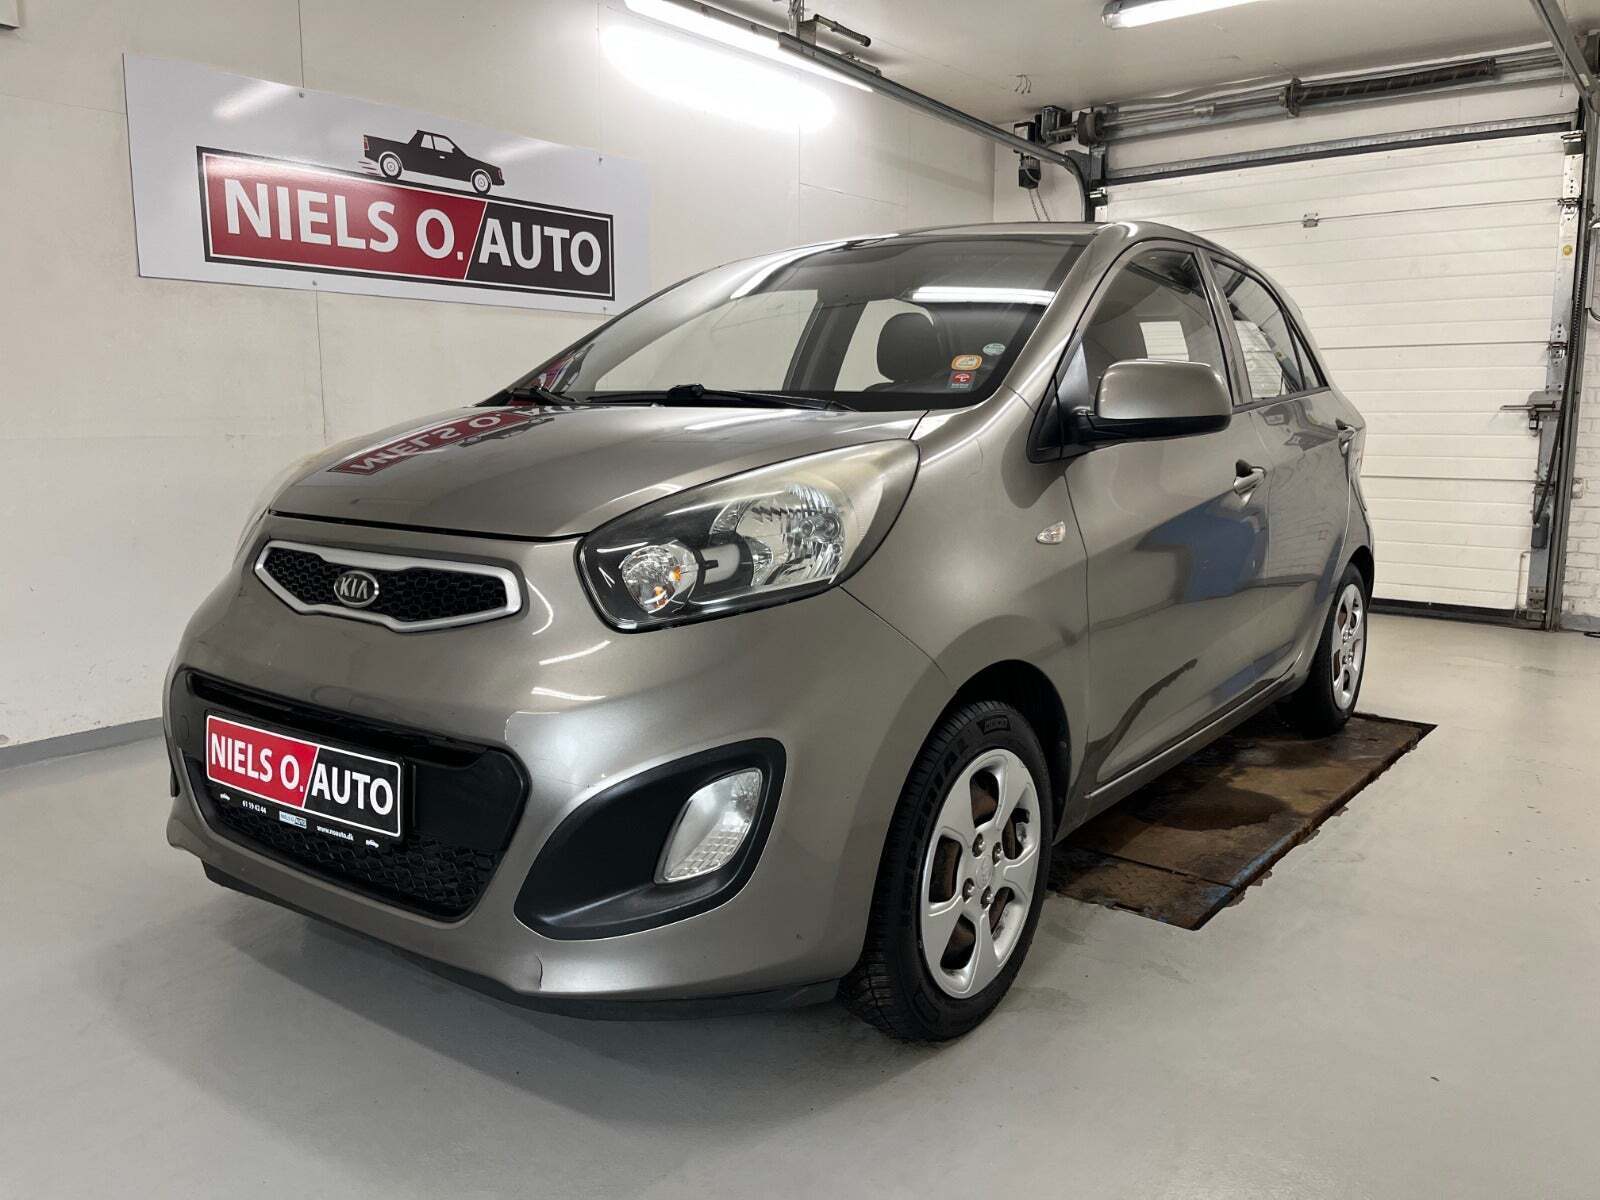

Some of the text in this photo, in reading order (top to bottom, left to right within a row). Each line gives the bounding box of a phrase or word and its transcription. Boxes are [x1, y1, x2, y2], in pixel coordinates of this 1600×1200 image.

[223, 178, 602, 276] NIELS O. AUTO
[340, 576, 368, 600] KIA
[211, 732, 394, 816] NIELS O. AUTO
